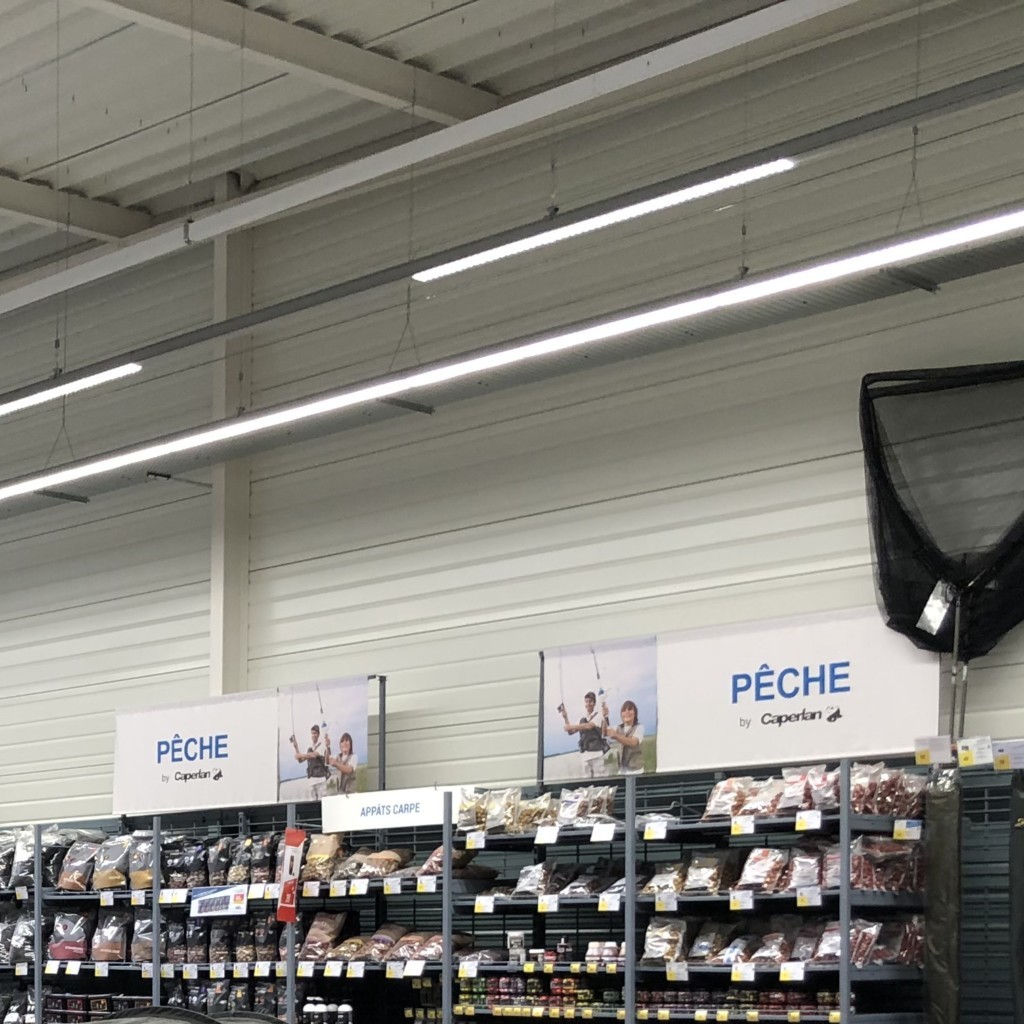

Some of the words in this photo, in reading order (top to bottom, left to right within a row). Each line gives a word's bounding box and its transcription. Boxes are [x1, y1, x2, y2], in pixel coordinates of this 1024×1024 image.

[731, 661, 851, 704] PÊCHE
[739, 717, 752, 729] by
[761, 708, 822, 727] Caperlan
[157, 733, 228, 764] PÊCHE
[161, 774, 170, 783] by
[174, 769, 211, 783] Caperlan
[393, 802, 420, 815] CARPE
